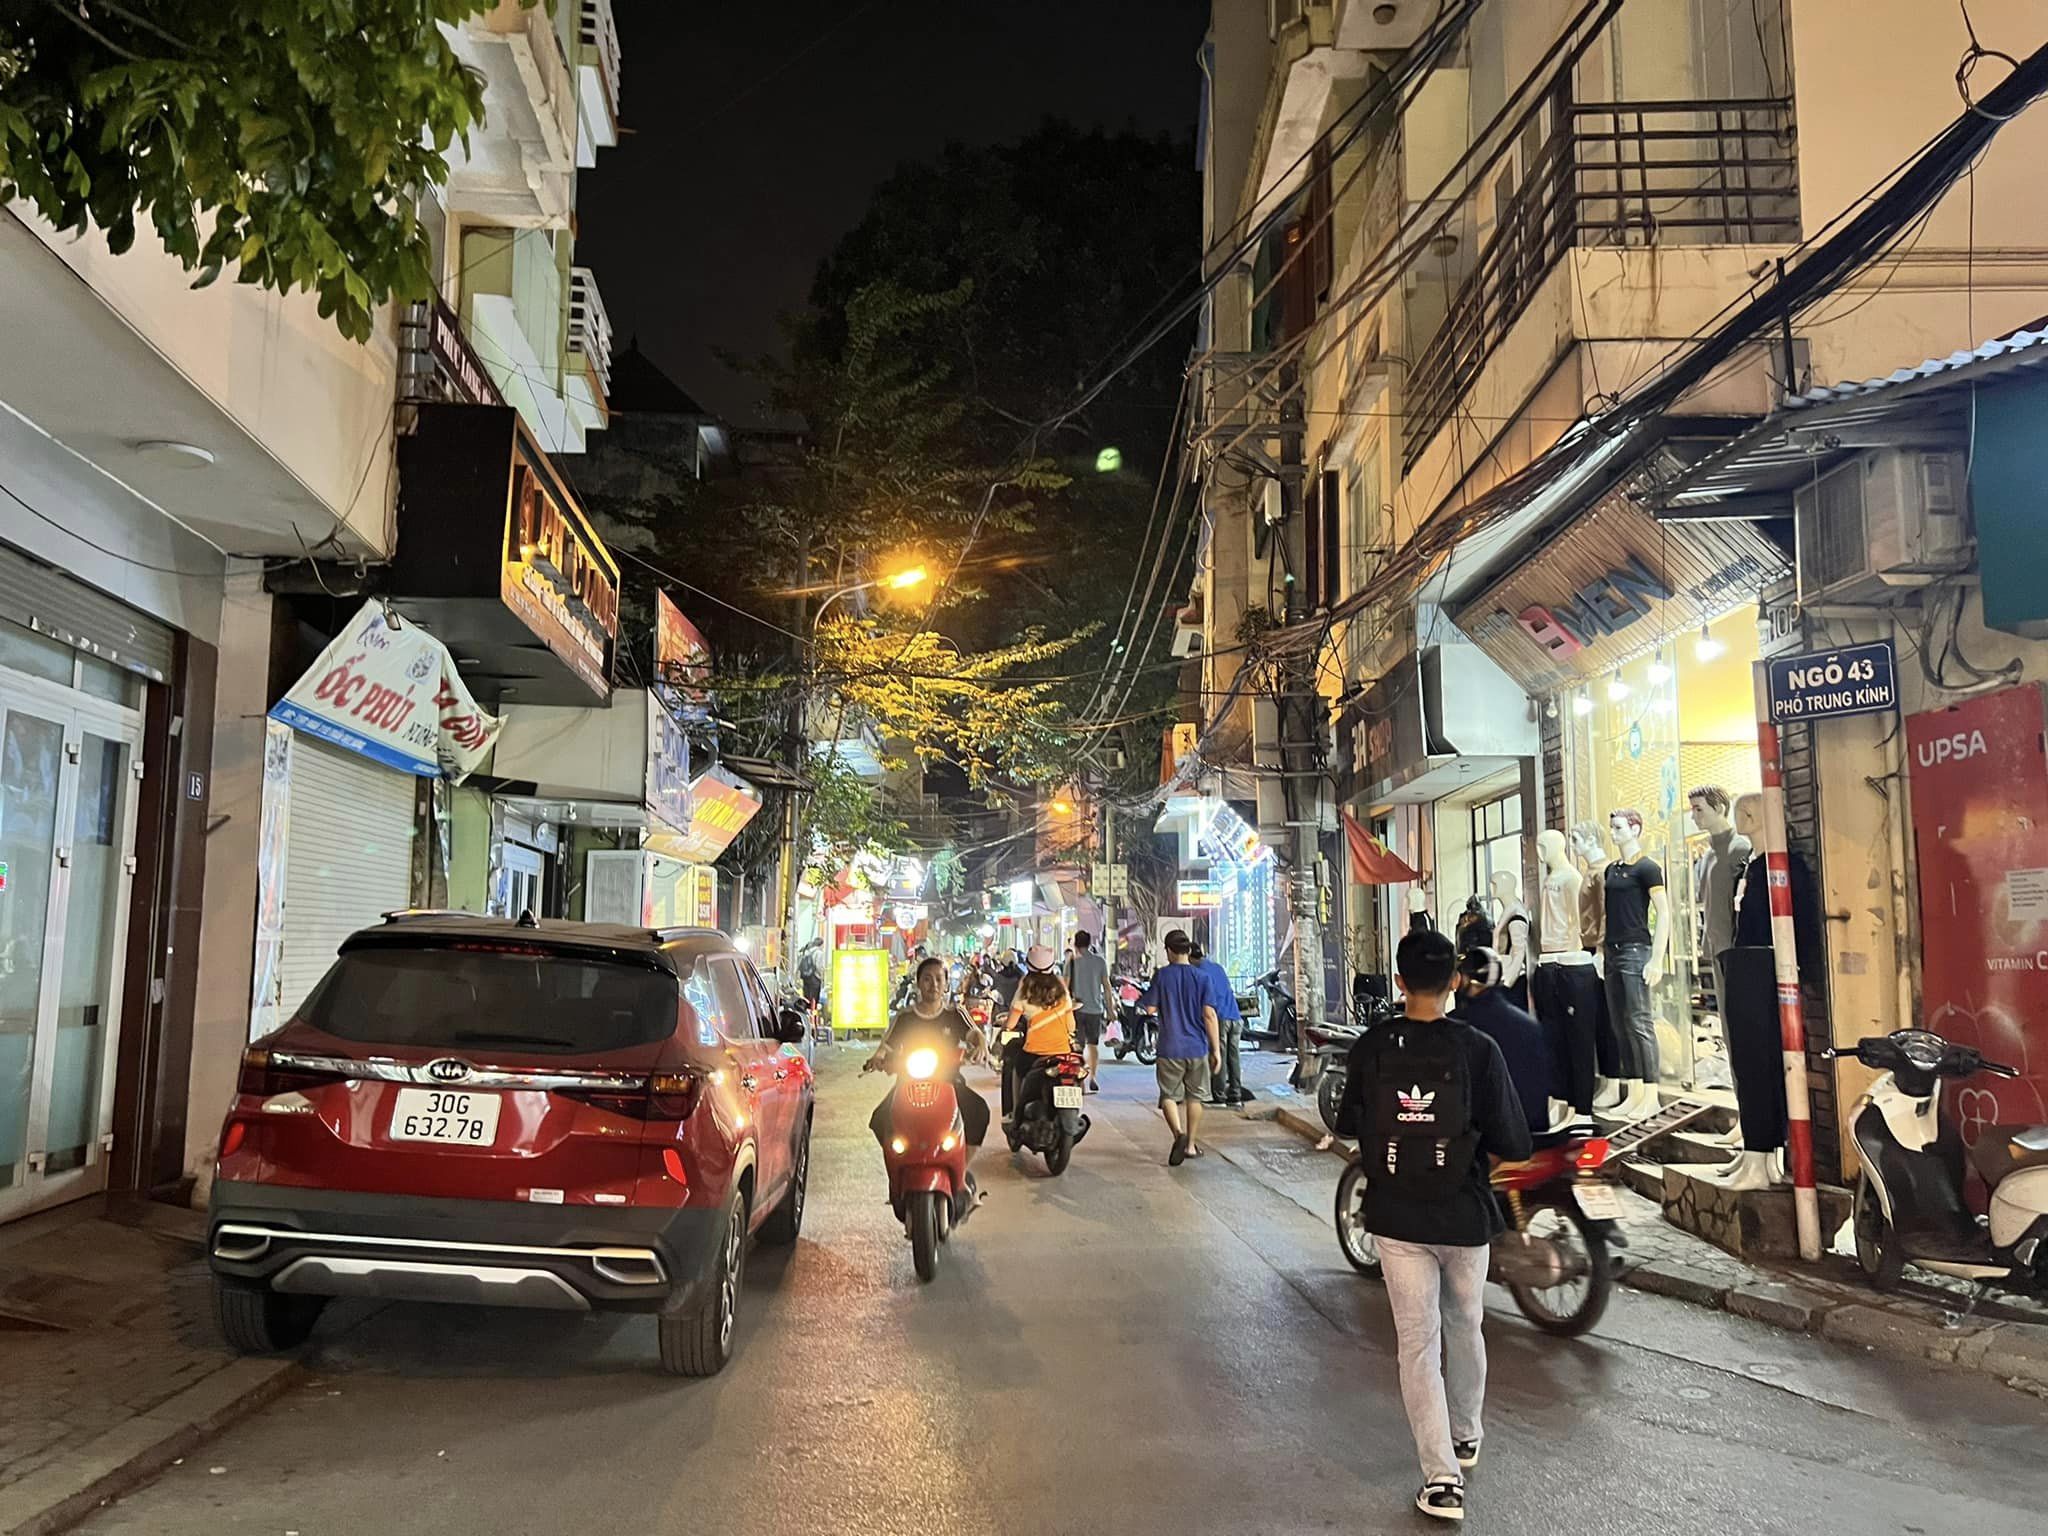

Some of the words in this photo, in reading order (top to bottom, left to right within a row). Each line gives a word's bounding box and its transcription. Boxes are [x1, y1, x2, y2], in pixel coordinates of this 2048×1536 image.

[315, 653, 367, 708] ỐC
[1788, 656, 1843, 690] NGÕ
[1848, 659, 1875, 681] 43
[1806, 692, 1852, 712] TRUNG
[1917, 729, 1988, 768] UPSA
[191, 775, 201, 797] 15
[1986, 958, 2034, 971] VITAMIN
[2036, 950, 2048, 971] C
[433, 1064, 464, 1078] KIA
[427, 1093, 470, 1115] 30G
[404, 1116, 484, 1140] 632.78
[1397, 1112, 1435, 1122] adidas
